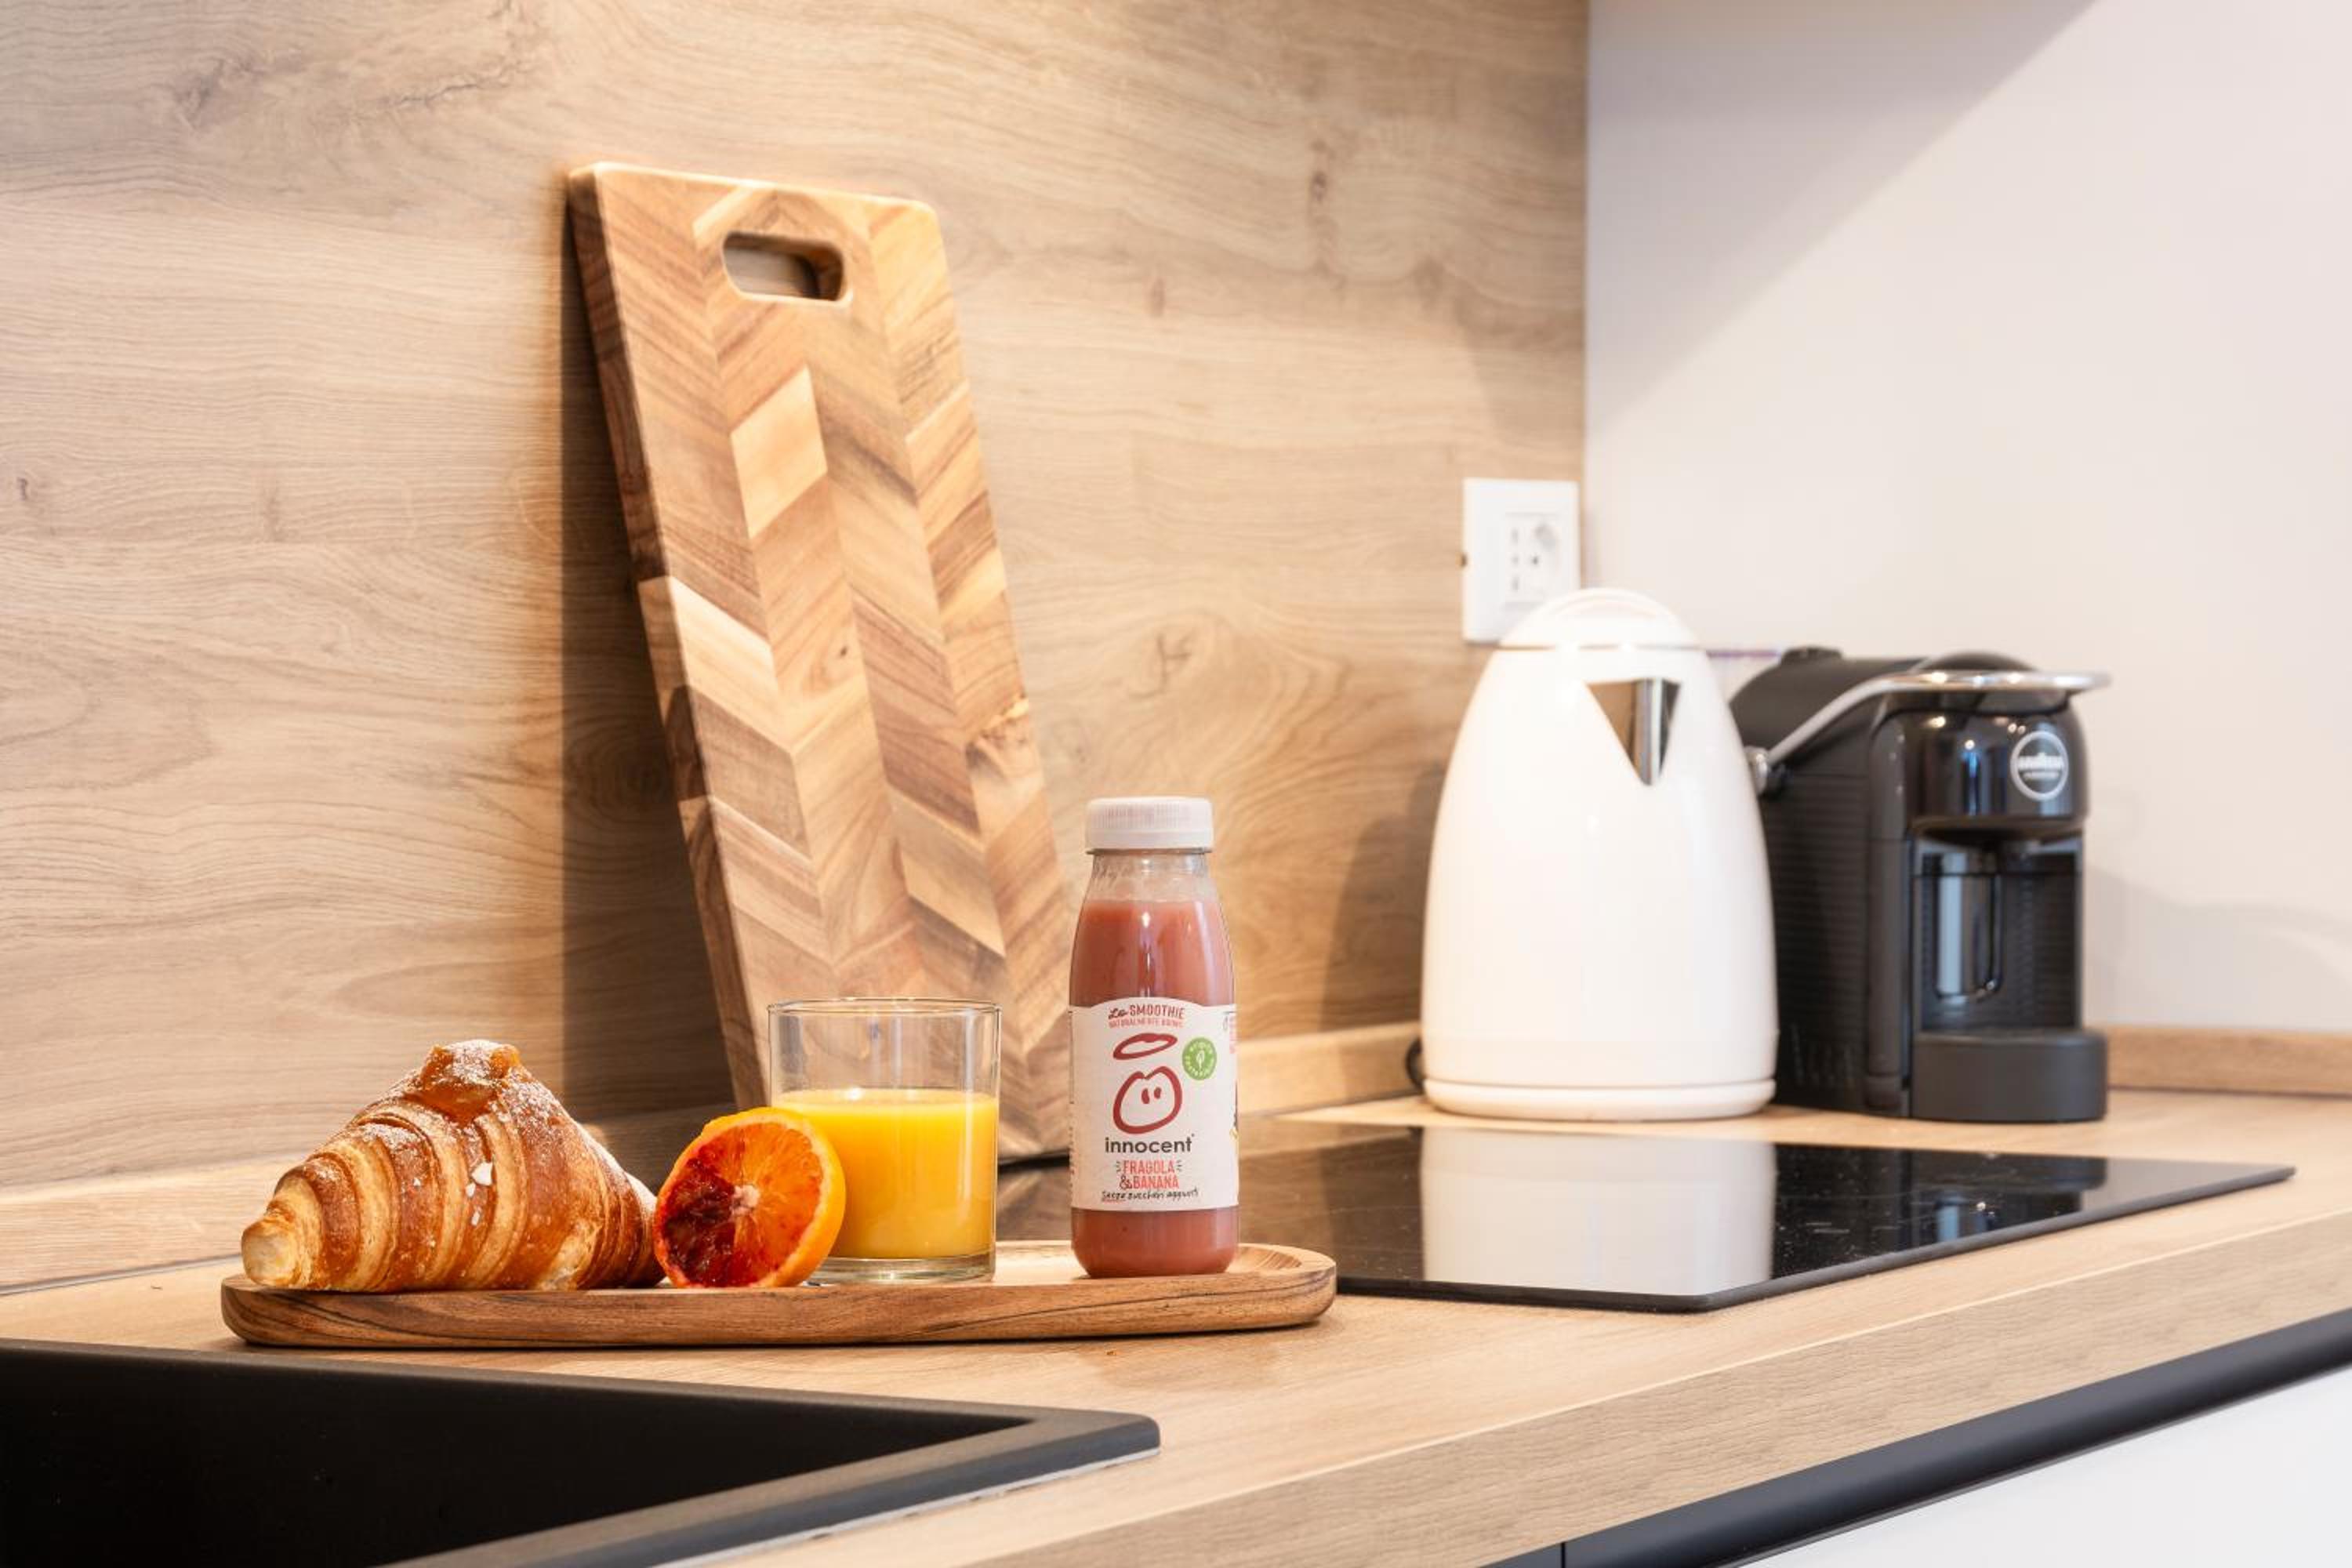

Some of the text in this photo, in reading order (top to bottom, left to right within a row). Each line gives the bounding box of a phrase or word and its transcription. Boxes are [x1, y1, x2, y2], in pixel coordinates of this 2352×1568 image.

[1130, 1004, 1185, 1018] SMOOTHIE
[1105, 1137, 1192, 1152] innocent
[1123, 1160, 1174, 1174] FRAGOLA
